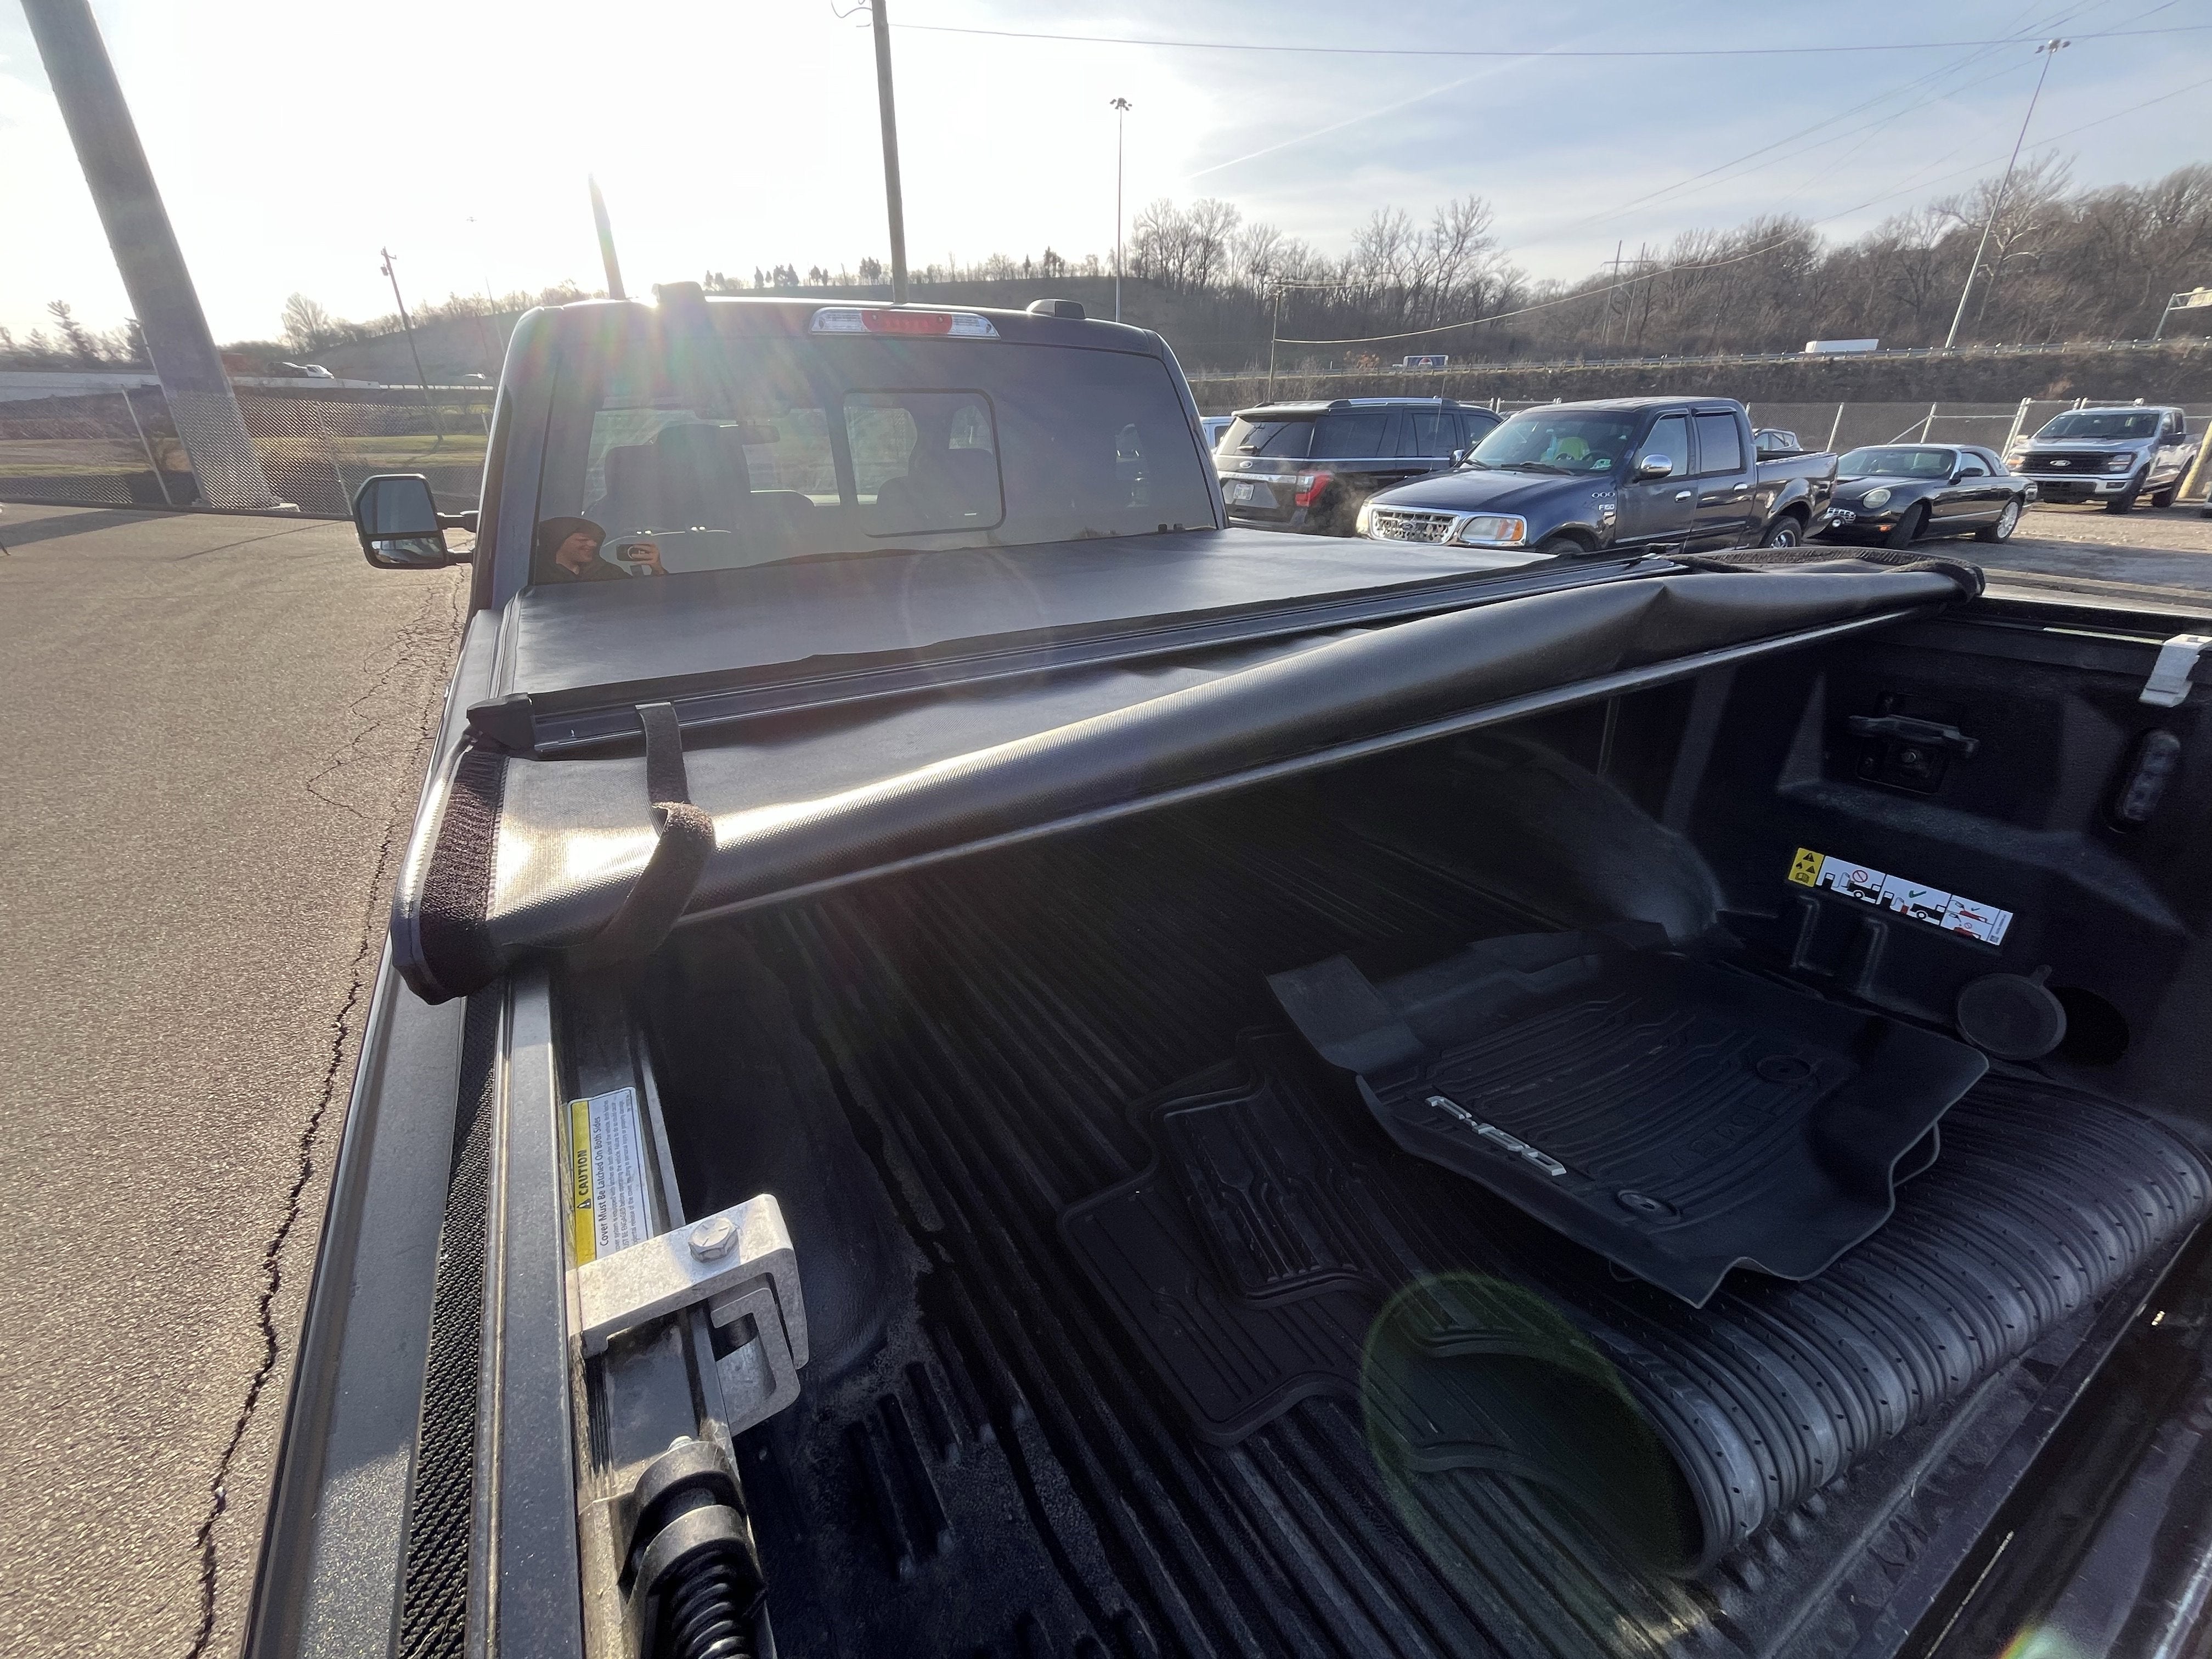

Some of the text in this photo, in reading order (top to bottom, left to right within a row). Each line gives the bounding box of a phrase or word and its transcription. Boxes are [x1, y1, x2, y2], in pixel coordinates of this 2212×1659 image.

[577, 1149, 588, 1196] CAUTION
[592, 1116, 608, 1246] Cover Must Be Latched On Both Sides
